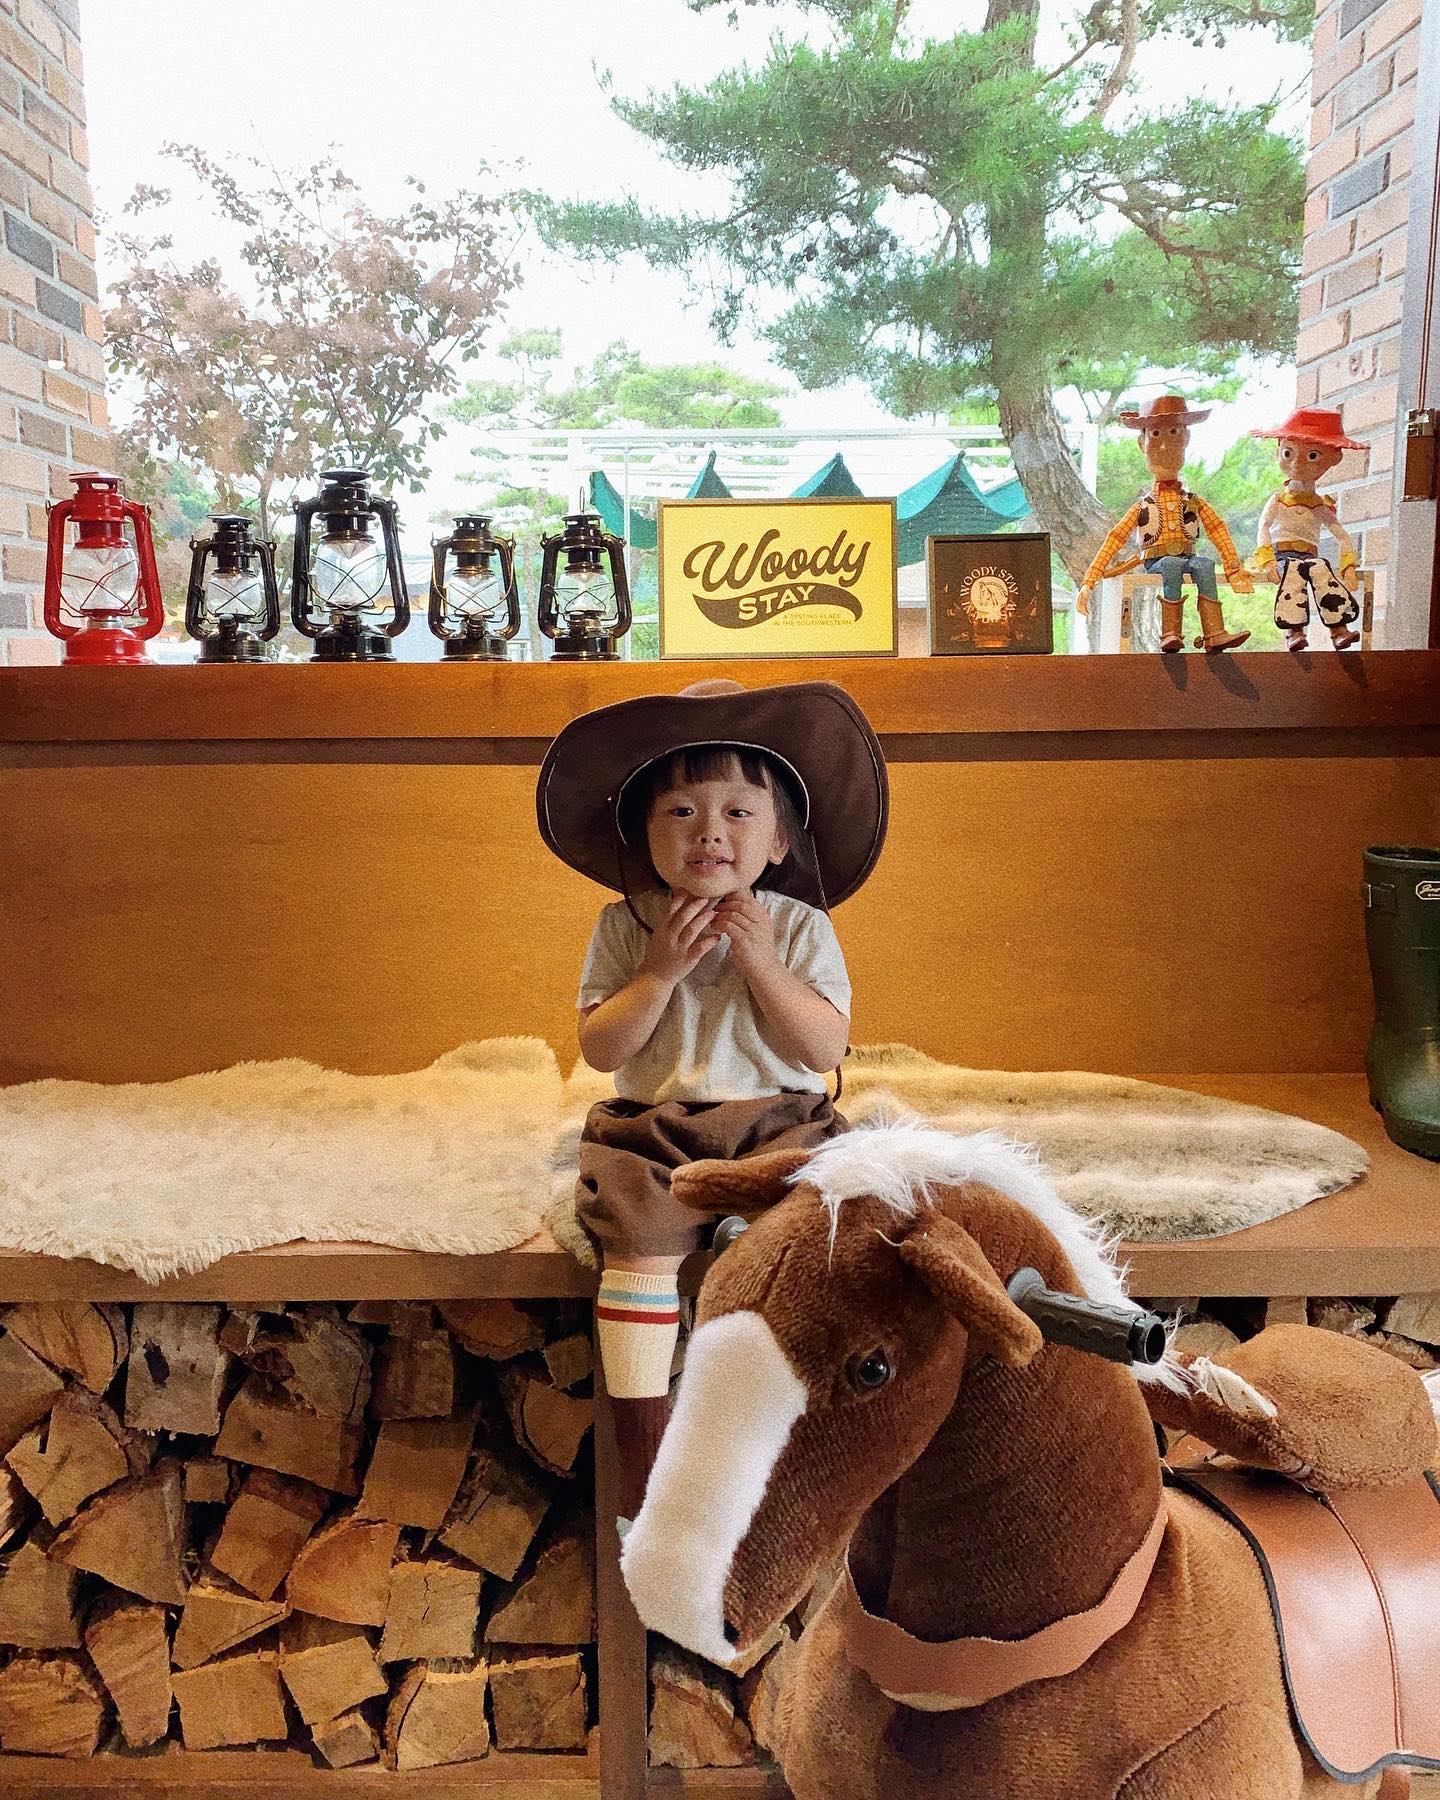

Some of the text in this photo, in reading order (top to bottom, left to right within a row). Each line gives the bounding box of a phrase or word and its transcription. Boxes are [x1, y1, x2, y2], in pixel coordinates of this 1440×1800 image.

[683, 528, 871, 592] Woody
[960, 566, 1019, 597] WOODY STAY
[738, 585, 817, 621] STAY
